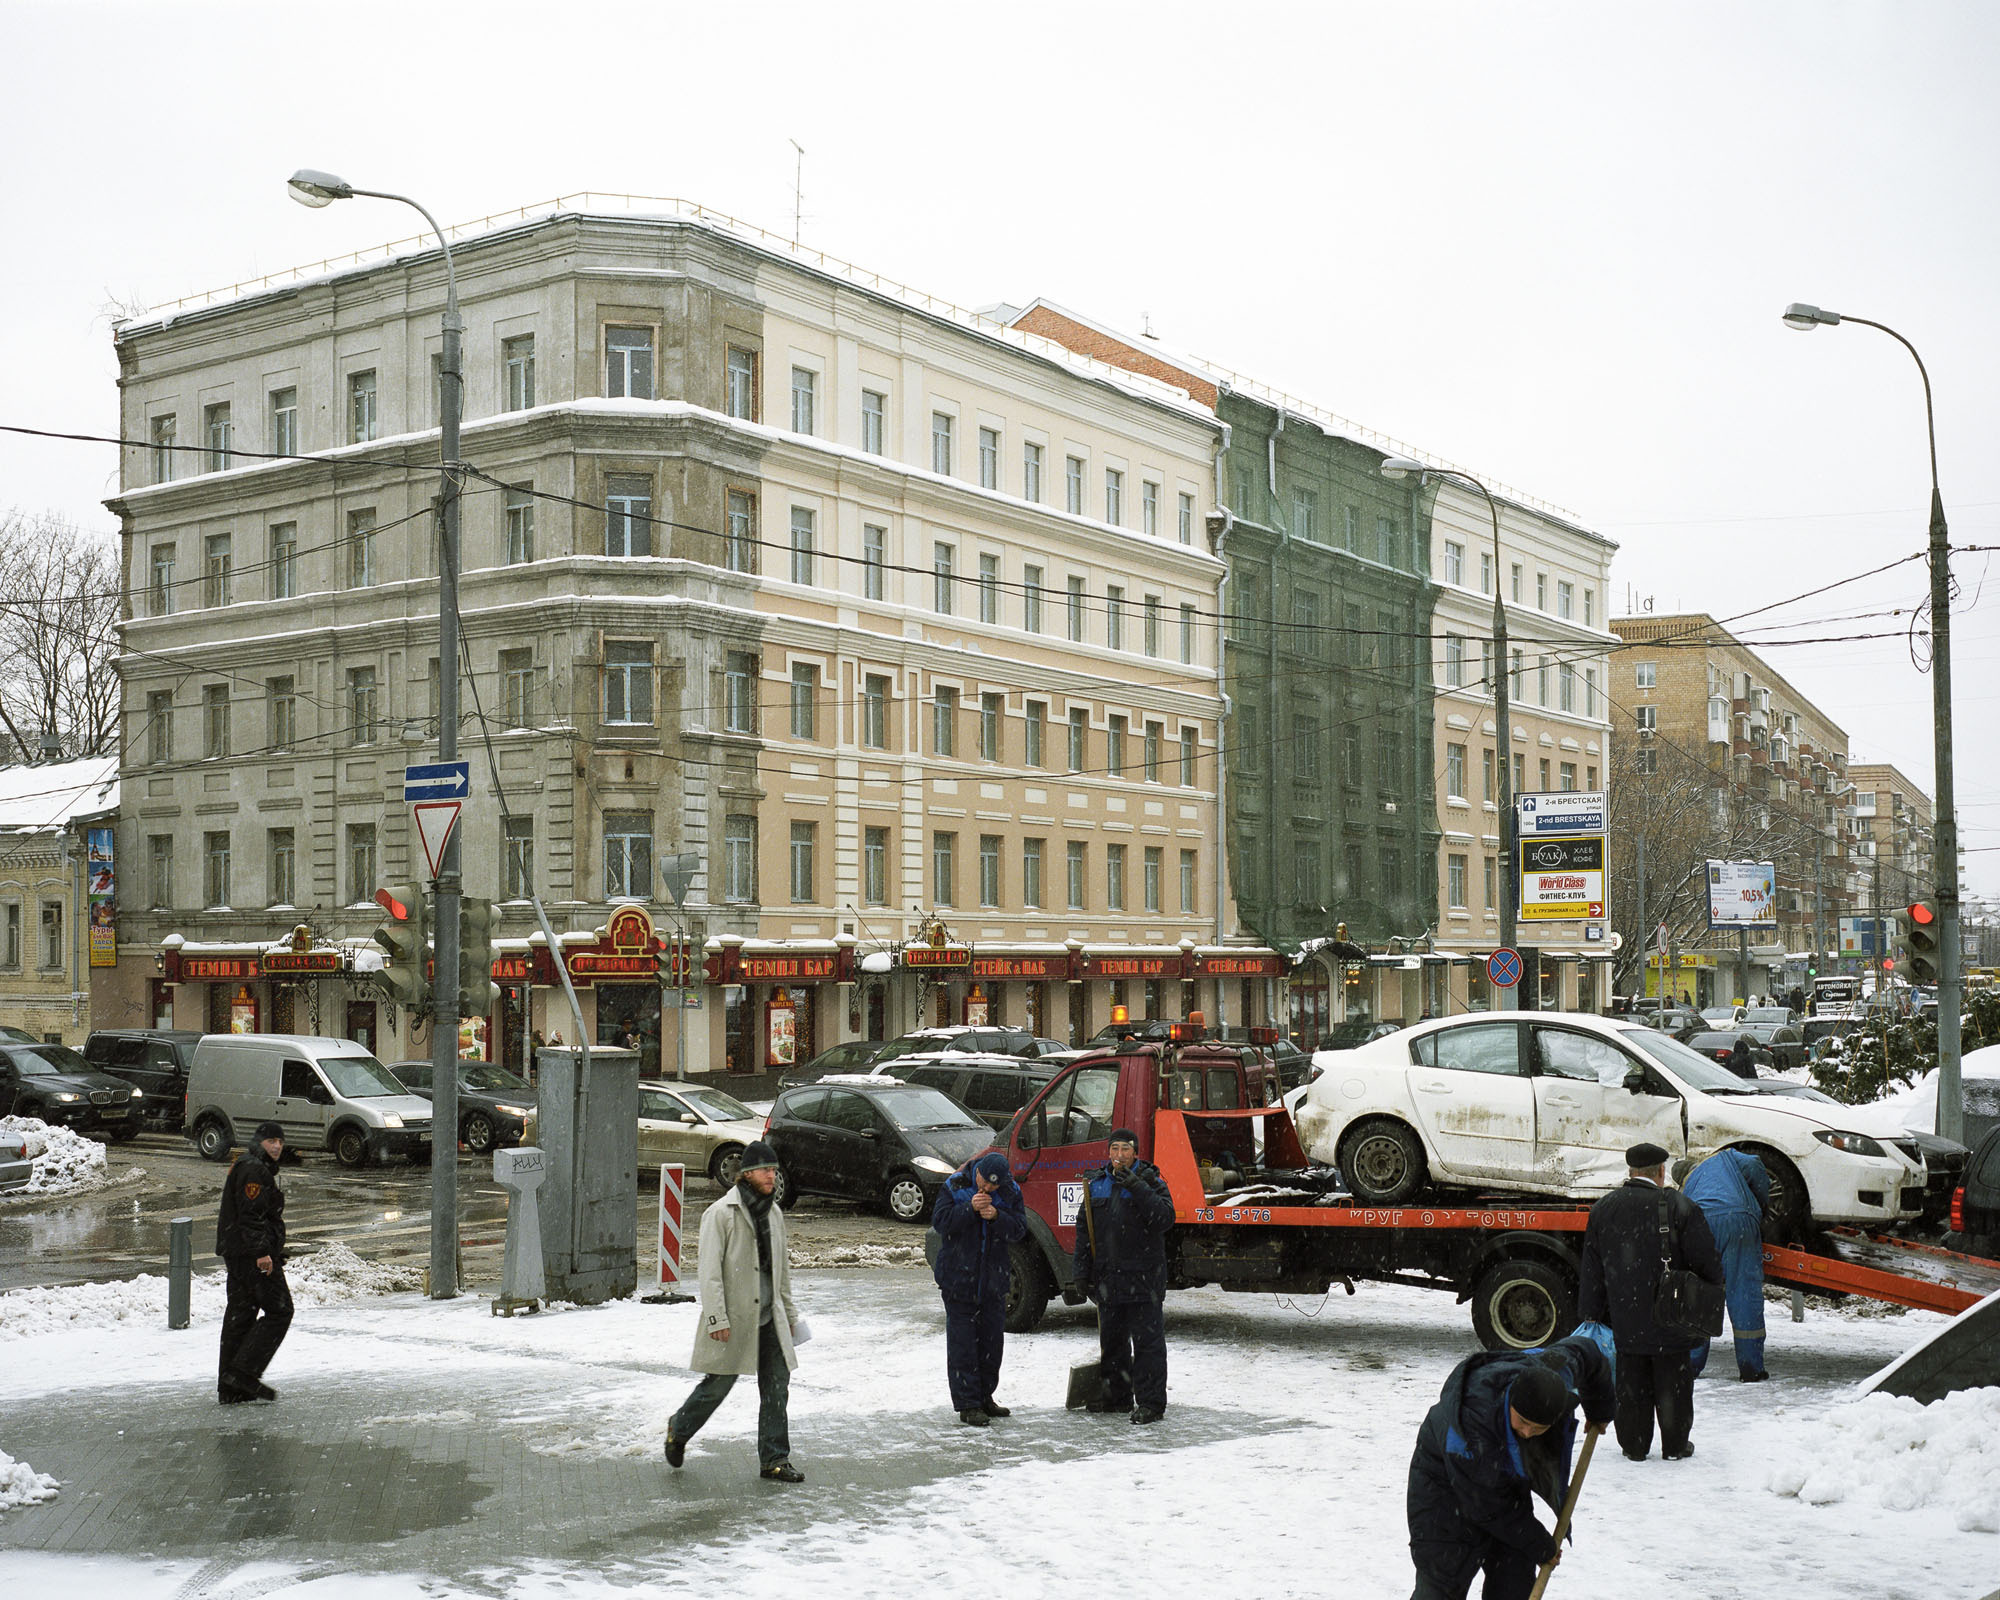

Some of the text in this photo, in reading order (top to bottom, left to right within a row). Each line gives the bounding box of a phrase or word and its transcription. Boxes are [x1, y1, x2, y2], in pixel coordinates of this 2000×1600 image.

[1558, 796, 1602, 805] БРЕСТСКАЯ
[1538, 814, 1601, 824] 2-nd BRESTSKAYA
[1531, 848, 1568, 861] БУЛКА
[1573, 855, 1593, 863] КОФЕ
[1540, 876, 1585, 889] World Class
[1539, 892, 1586, 900] ФИТНЕС-КЛУБ
[1741, 889, 1765, 904] 10,5%
[188, 960, 240, 977] ТЕМПЛ
[746, 959, 834, 977] ТЕМПЛ БАР
[973, 957, 1046, 976] СТЕЙК & ПАБ
[1100, 959, 1164, 975] ТЕМПЛ БАР
[1207, 957, 1239, 974] СТЕЙК
[1244, 959, 1263, 974] ПАБ
[1816, 982, 1852, 990] АВТОМОЙКА
[1061, 1186, 1075, 1203] 43
